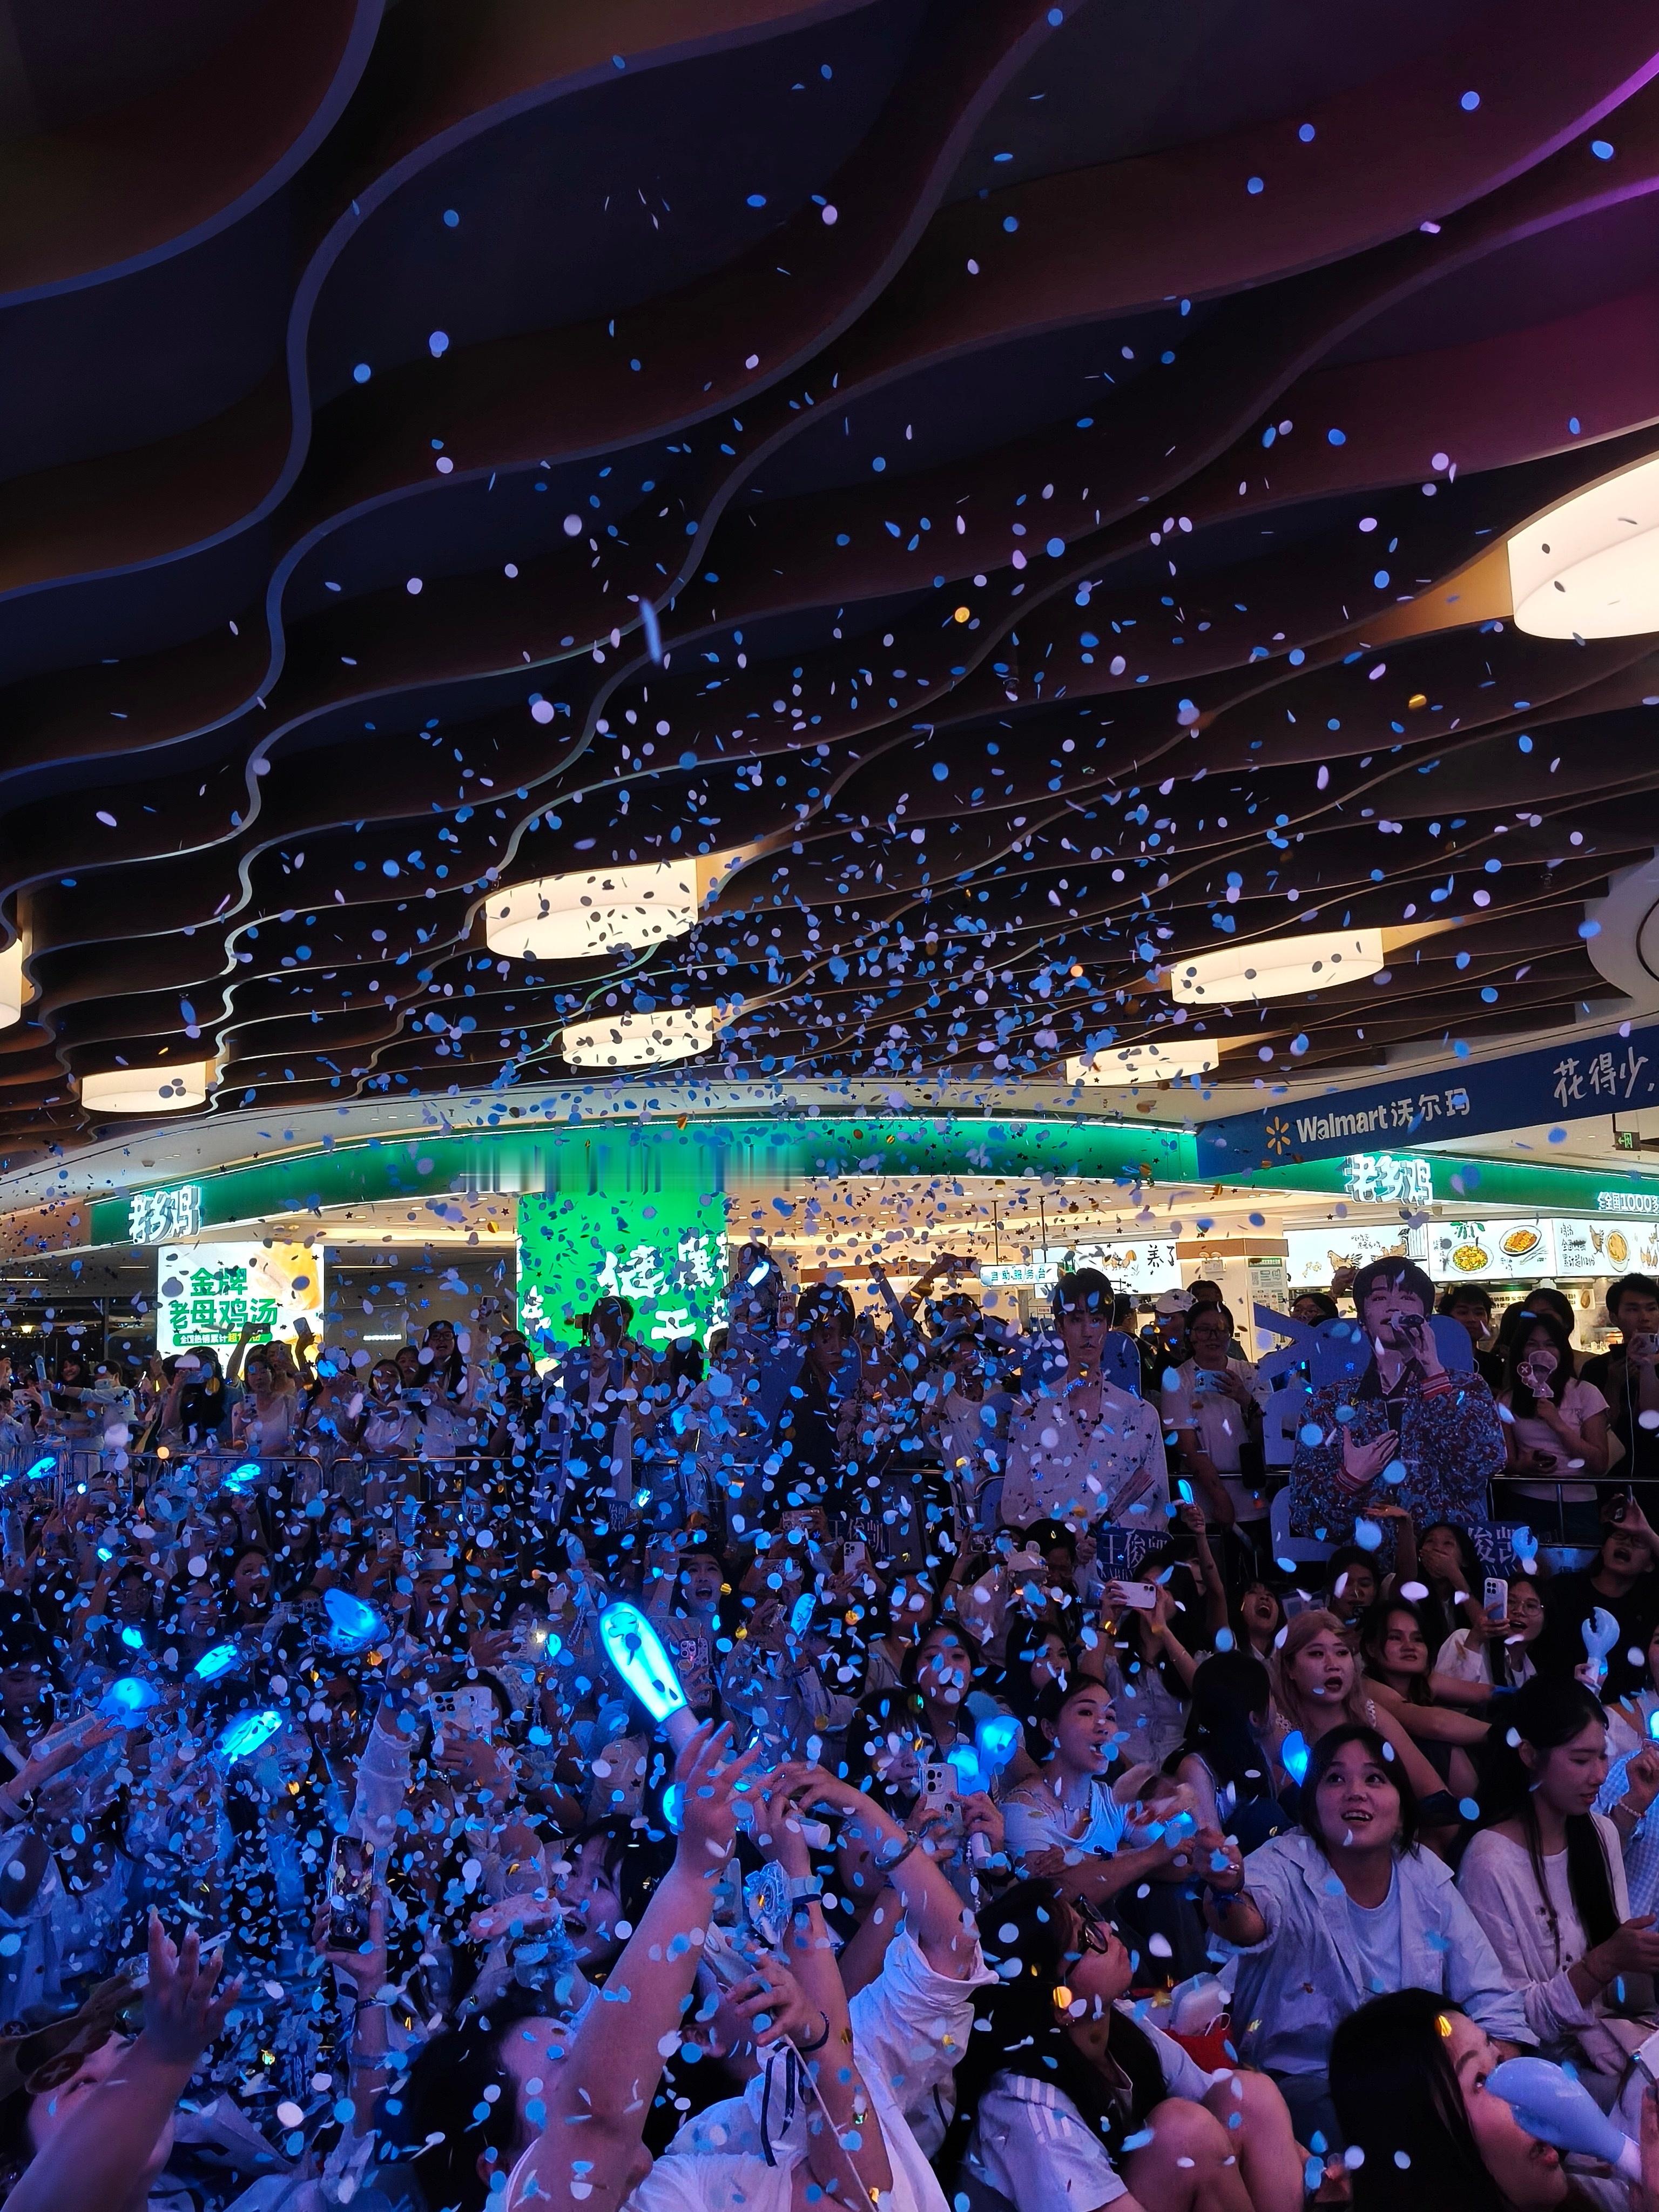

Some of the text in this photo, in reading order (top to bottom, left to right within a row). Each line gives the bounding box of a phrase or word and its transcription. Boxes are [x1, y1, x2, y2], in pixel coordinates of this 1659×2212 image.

[1297, 1105, 1387, 1143] Walmart
[1390, 1088, 1470, 1127] 沃尔玛
[1344, 1154, 1433, 1206] 老乡鸡
[129, 1184, 201, 1244] 老乡鸡
[190, 1267, 247, 1296] 金牌
[991, 1268, 1046, 1282] 自助服务台
[168, 1298, 278, 1329] 老母鸡汤
